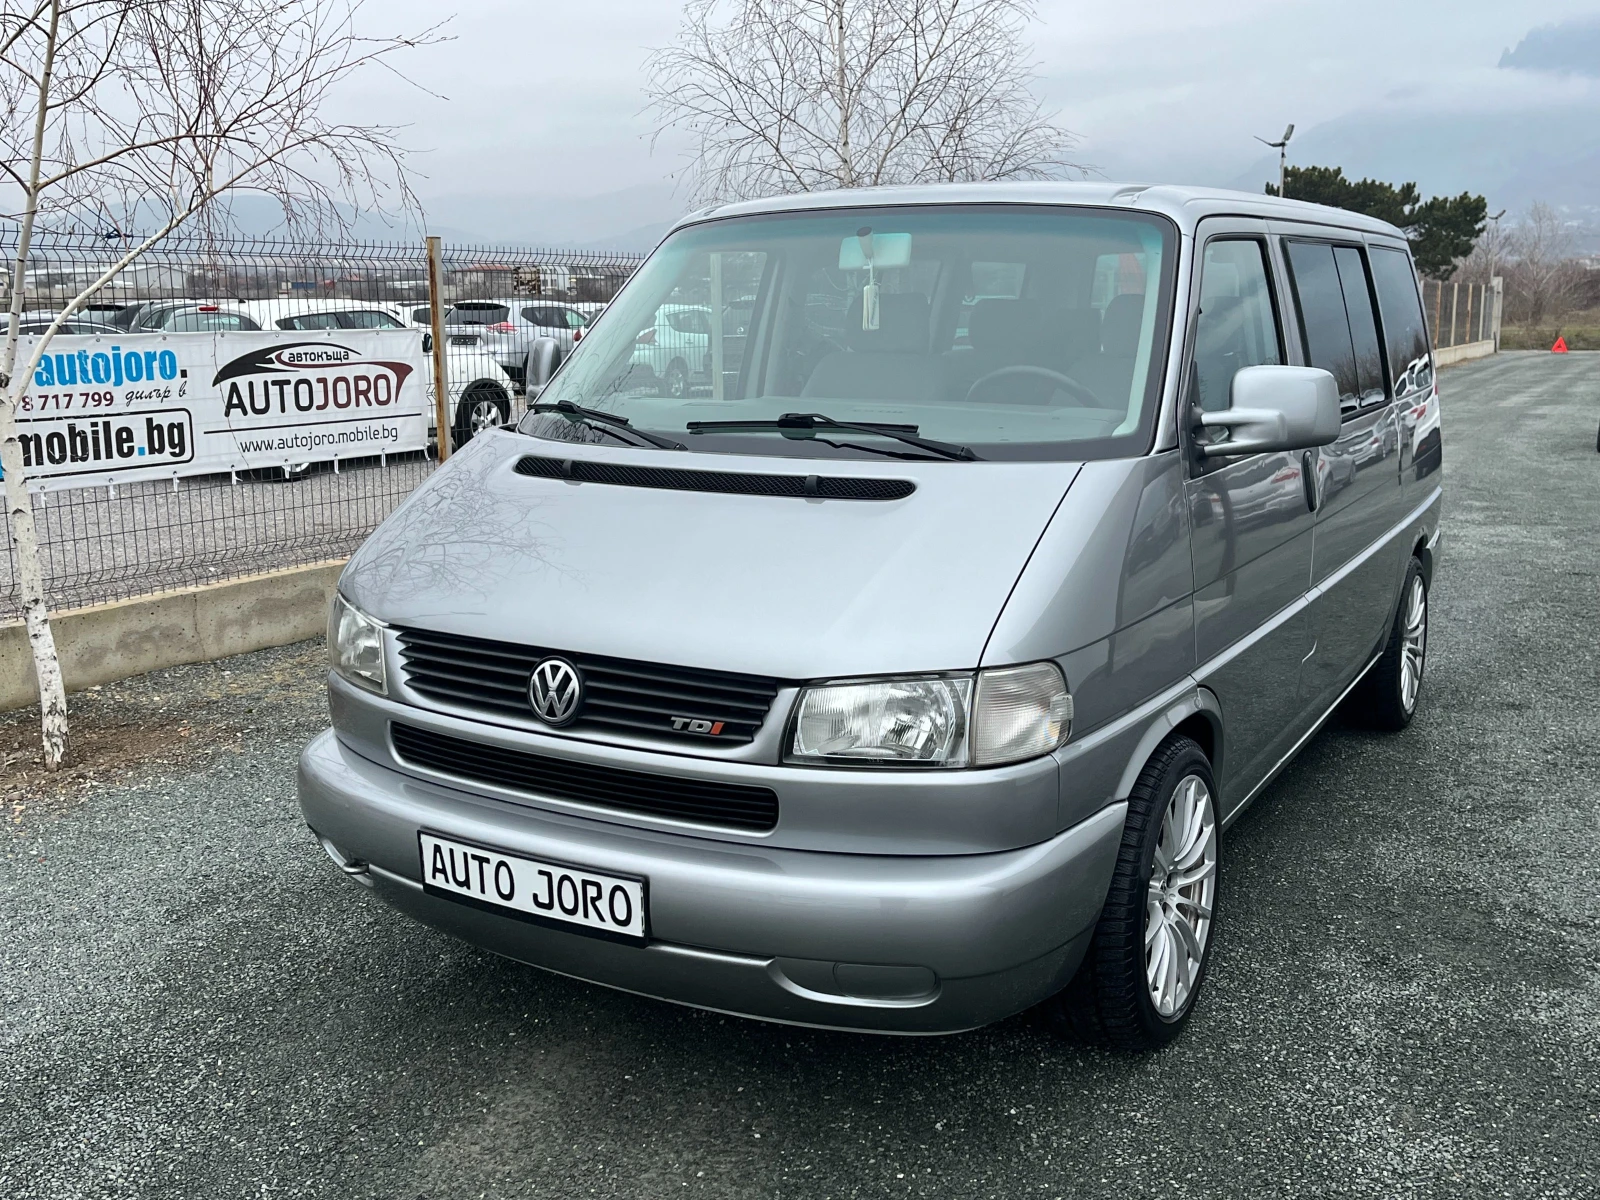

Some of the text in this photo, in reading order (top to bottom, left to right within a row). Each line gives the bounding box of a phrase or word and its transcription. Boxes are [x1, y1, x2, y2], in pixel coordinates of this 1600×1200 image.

[288, 350, 350, 363] автокъща
[38, 393, 74, 411] 717
[79, 391, 114, 408] 799
[224, 374, 392, 417] AUTOJORO
[18, 417, 186, 467] mobile.bg
[240, 424, 398, 453] www.autojoro.mobile.bg
[671, 716, 725, 735] TDI
[431, 843, 633, 928] AUTO JORO
